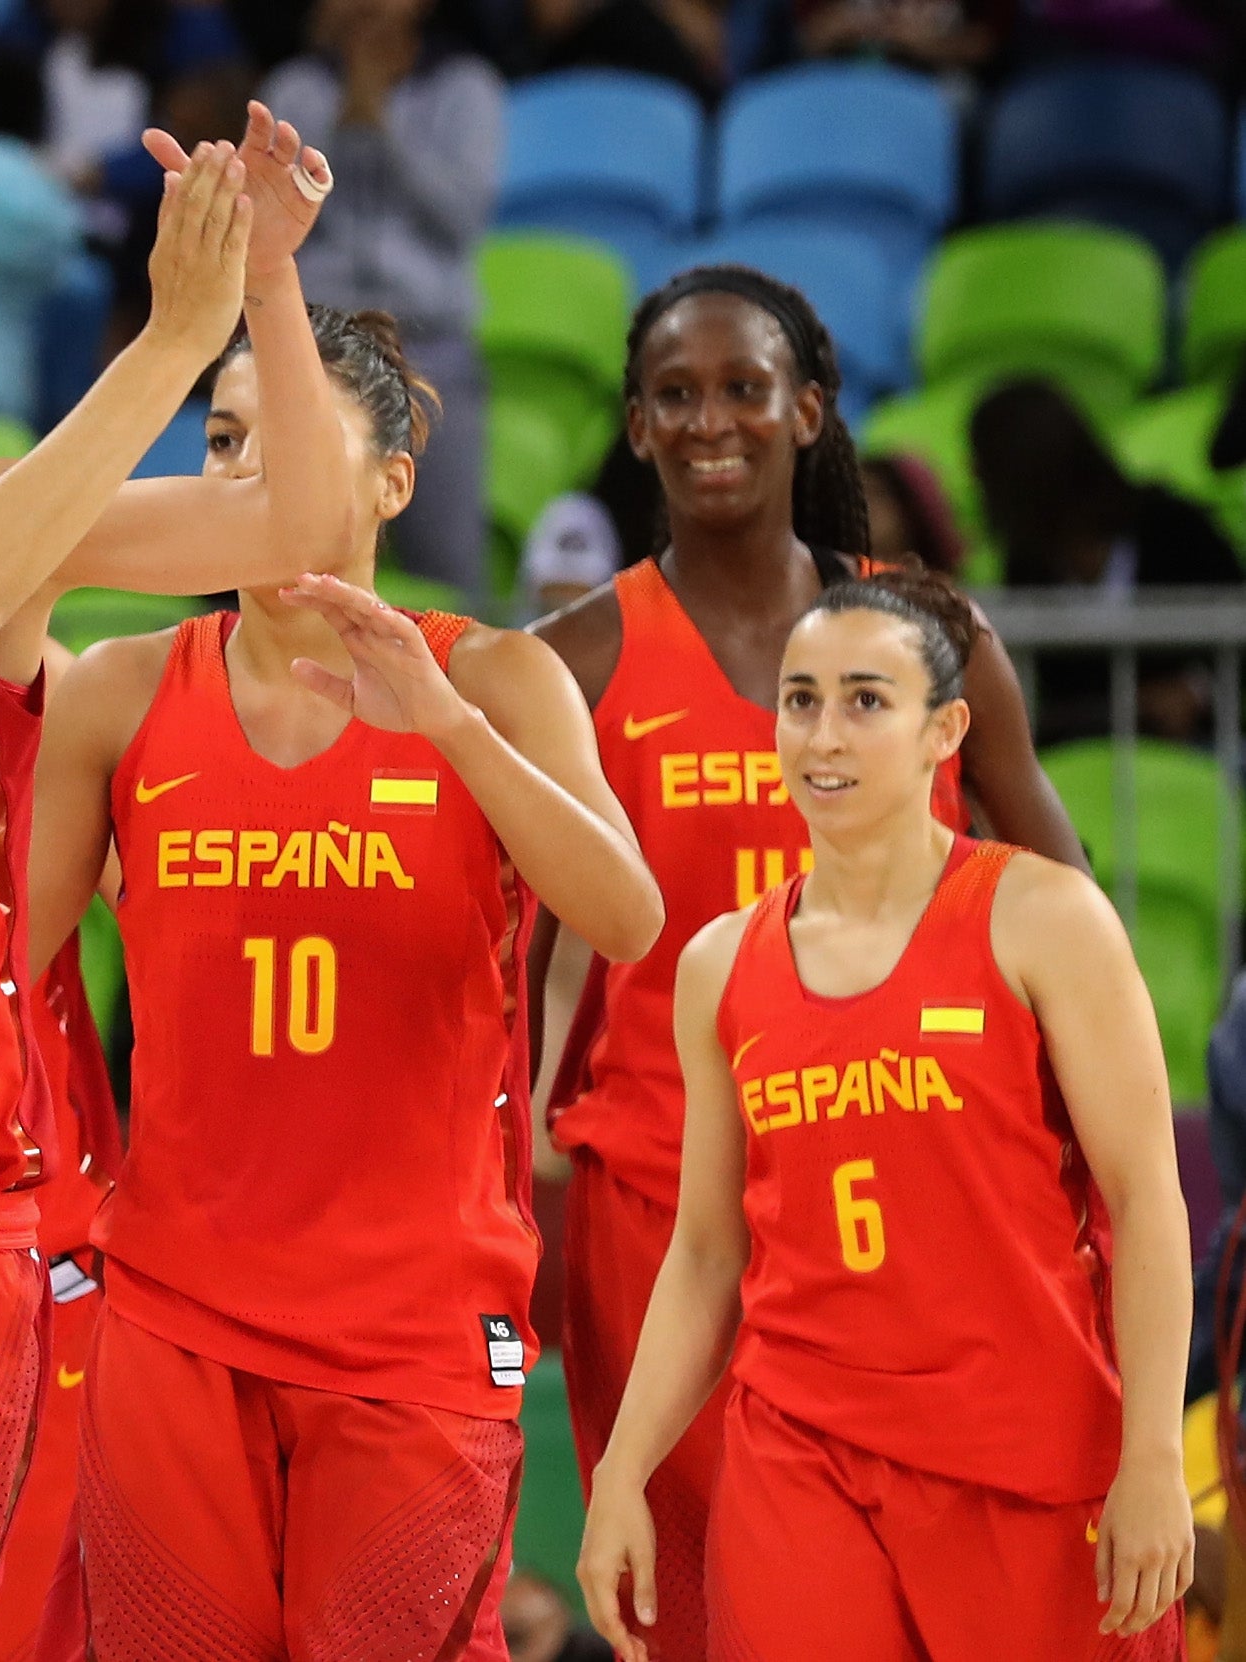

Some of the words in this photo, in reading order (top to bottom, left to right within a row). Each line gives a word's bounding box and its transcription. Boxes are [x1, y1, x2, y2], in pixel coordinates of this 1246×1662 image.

[661, 752, 790, 808] ESP
[157, 820, 414, 890] ESPAÑA
[243, 935, 338, 1056] 10
[742, 1047, 964, 1136] ESPAÑA
[832, 1158, 886, 1273] 6
